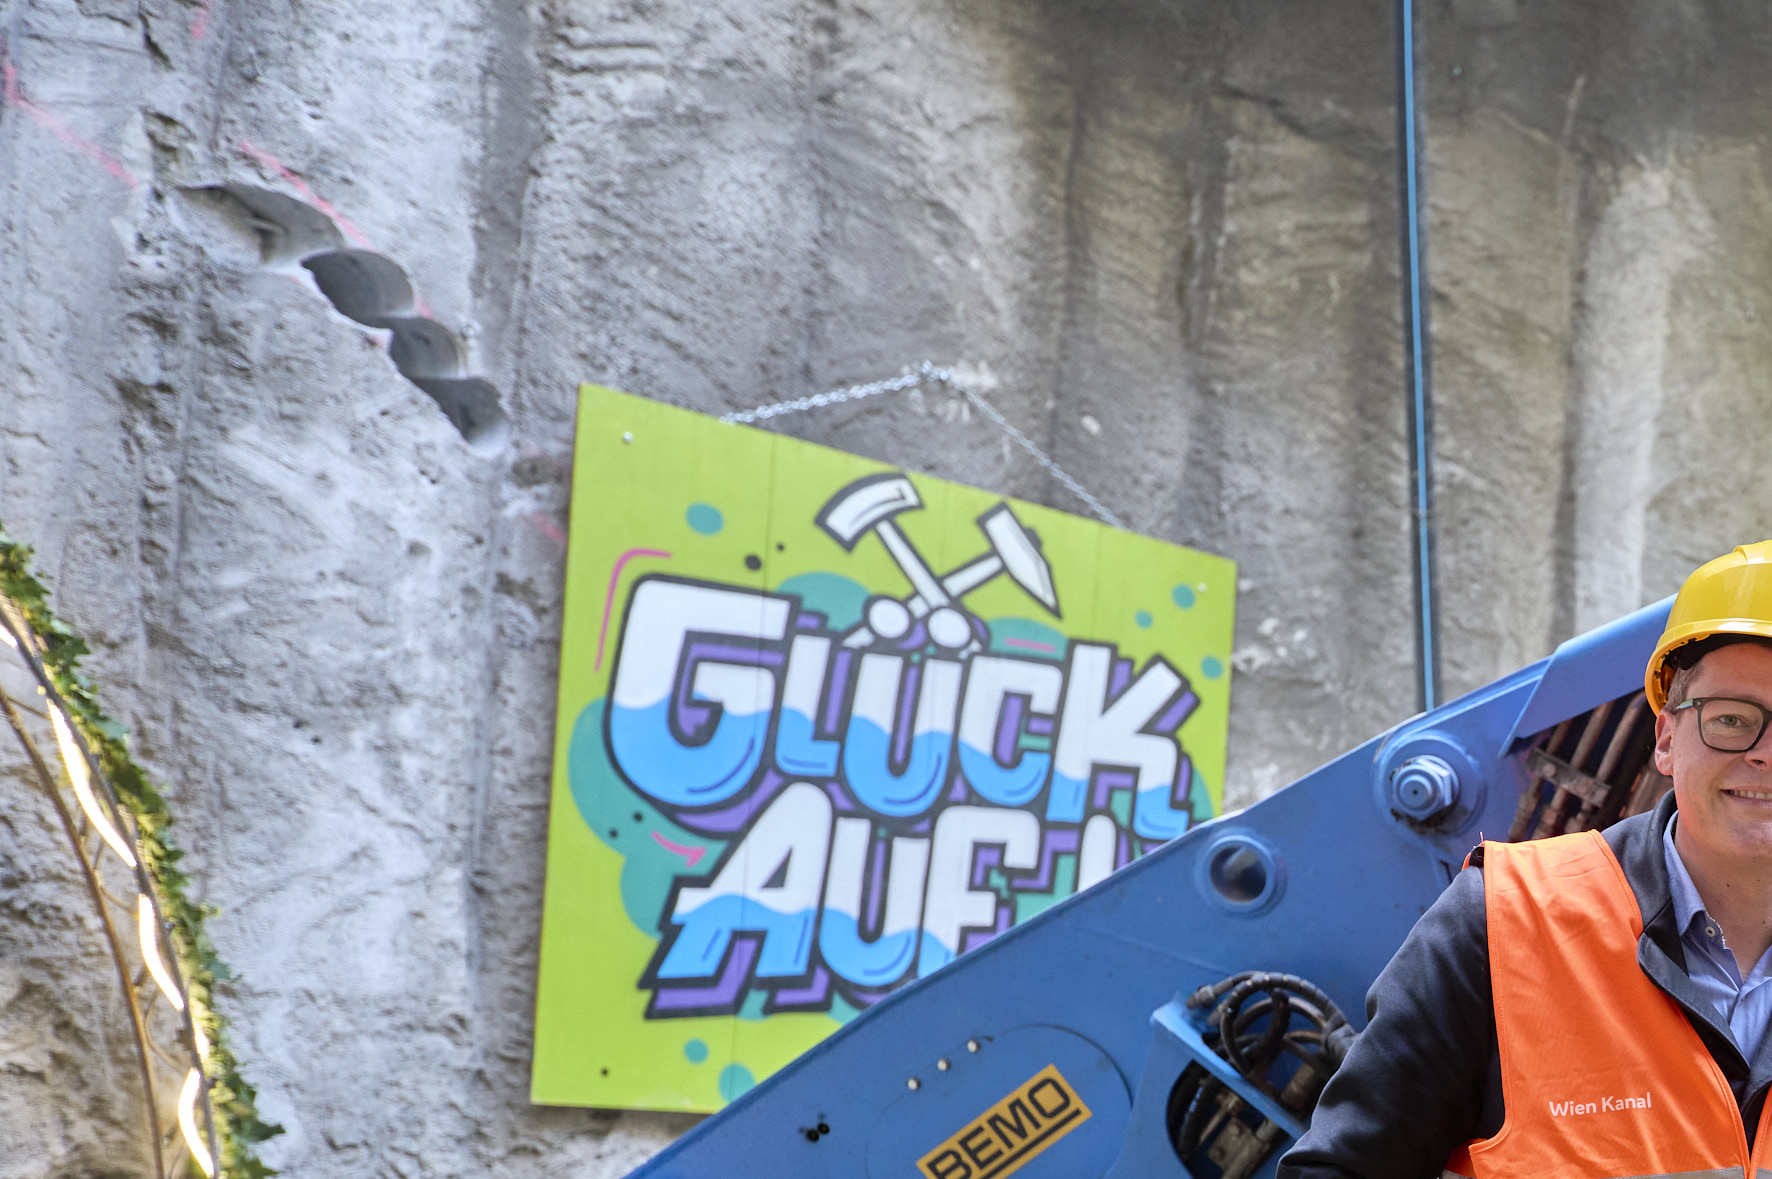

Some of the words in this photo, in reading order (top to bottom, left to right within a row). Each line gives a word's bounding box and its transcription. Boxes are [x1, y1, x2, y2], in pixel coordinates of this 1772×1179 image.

[603, 572, 1200, 842] GLÜCK
[1548, 1100, 1597, 1117] Wien
[1601, 1091, 1652, 1113] Kanal
